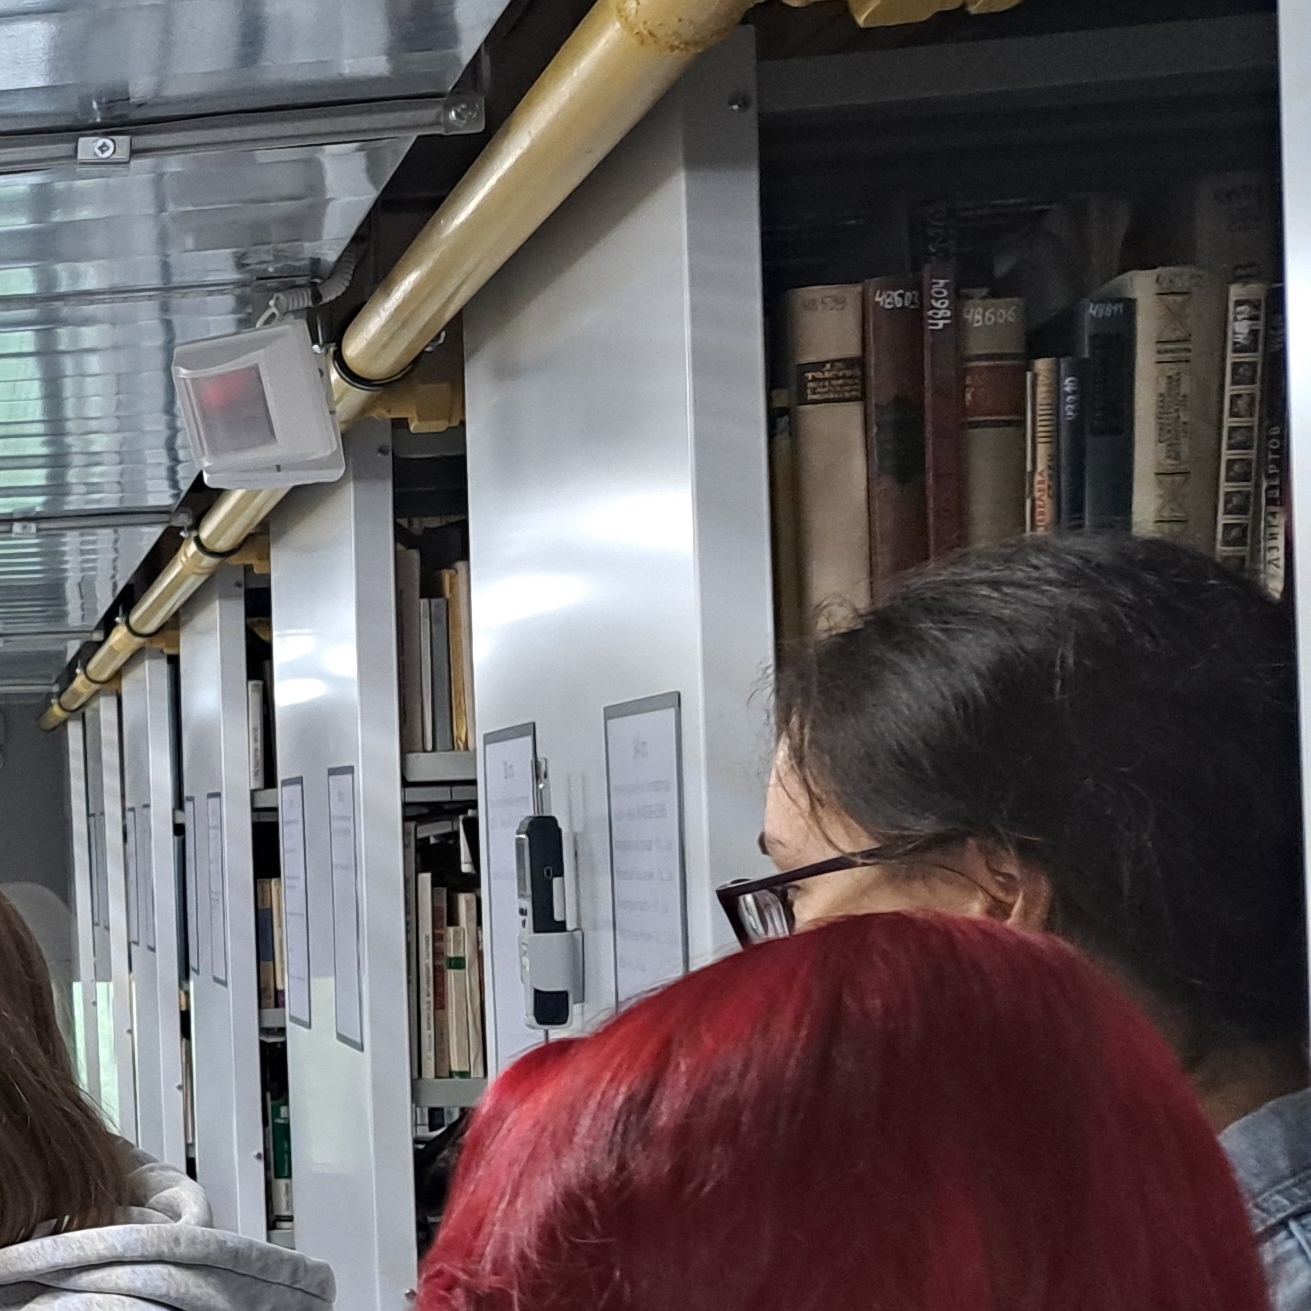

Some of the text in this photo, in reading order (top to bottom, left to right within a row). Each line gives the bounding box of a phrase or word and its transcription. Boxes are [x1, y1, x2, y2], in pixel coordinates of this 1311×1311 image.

[927, 279, 952, 330] 48604
[964, 306, 1017, 327] 48606
[1266, 425, 1280, 499] ВЕРТОВ
